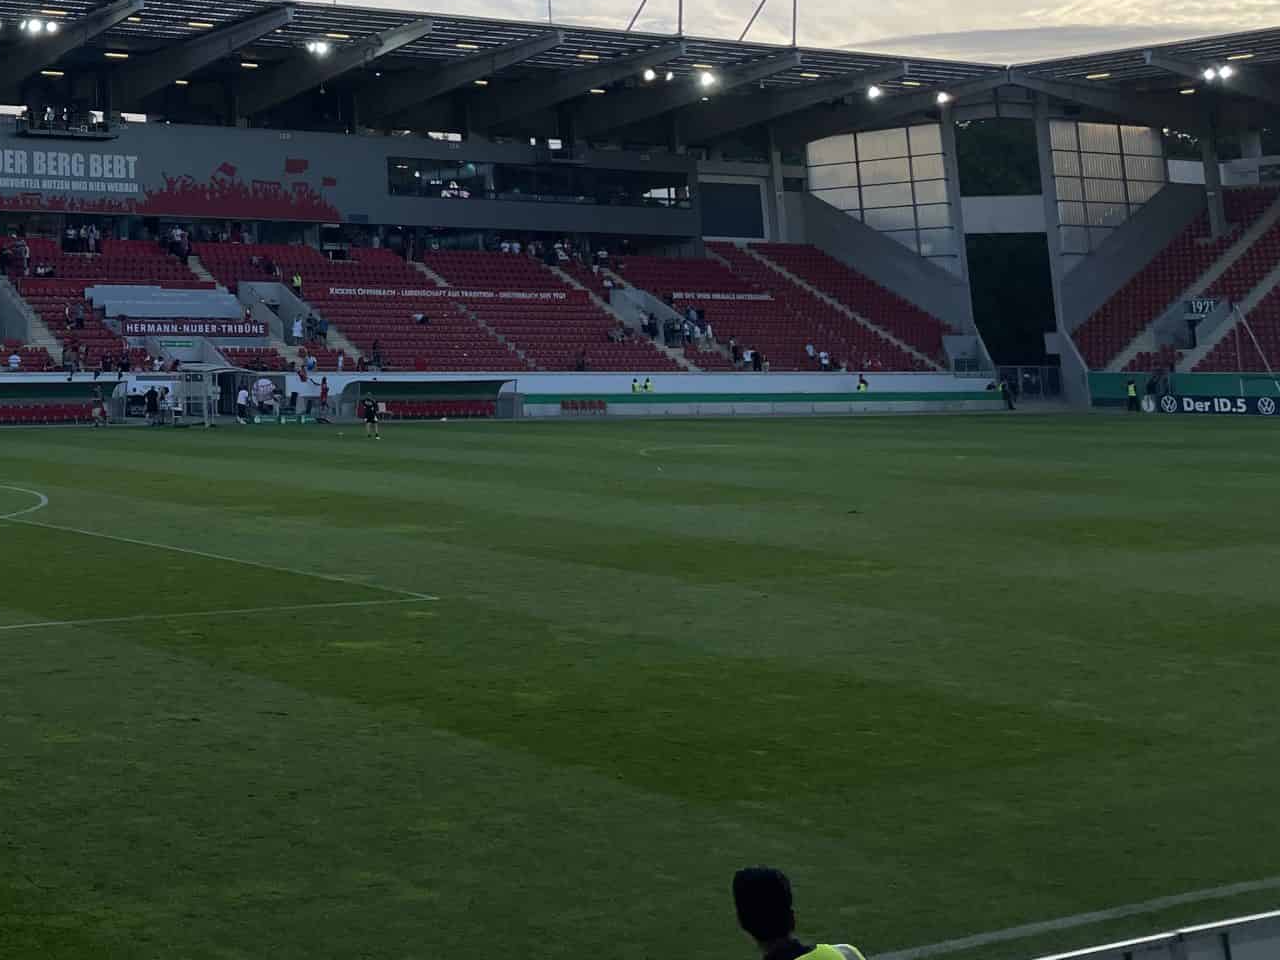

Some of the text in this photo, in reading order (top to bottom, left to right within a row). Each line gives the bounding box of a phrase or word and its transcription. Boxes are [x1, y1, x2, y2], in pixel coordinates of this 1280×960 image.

[32, 150, 85, 177] BERG
[89, 153, 138, 179] BEBT
[126, 321, 265, 334] HERMANN-NUBER-TRIBÜNE
[1182, 397, 1211, 413] Der
[1214, 398, 1247, 414] ID.5
